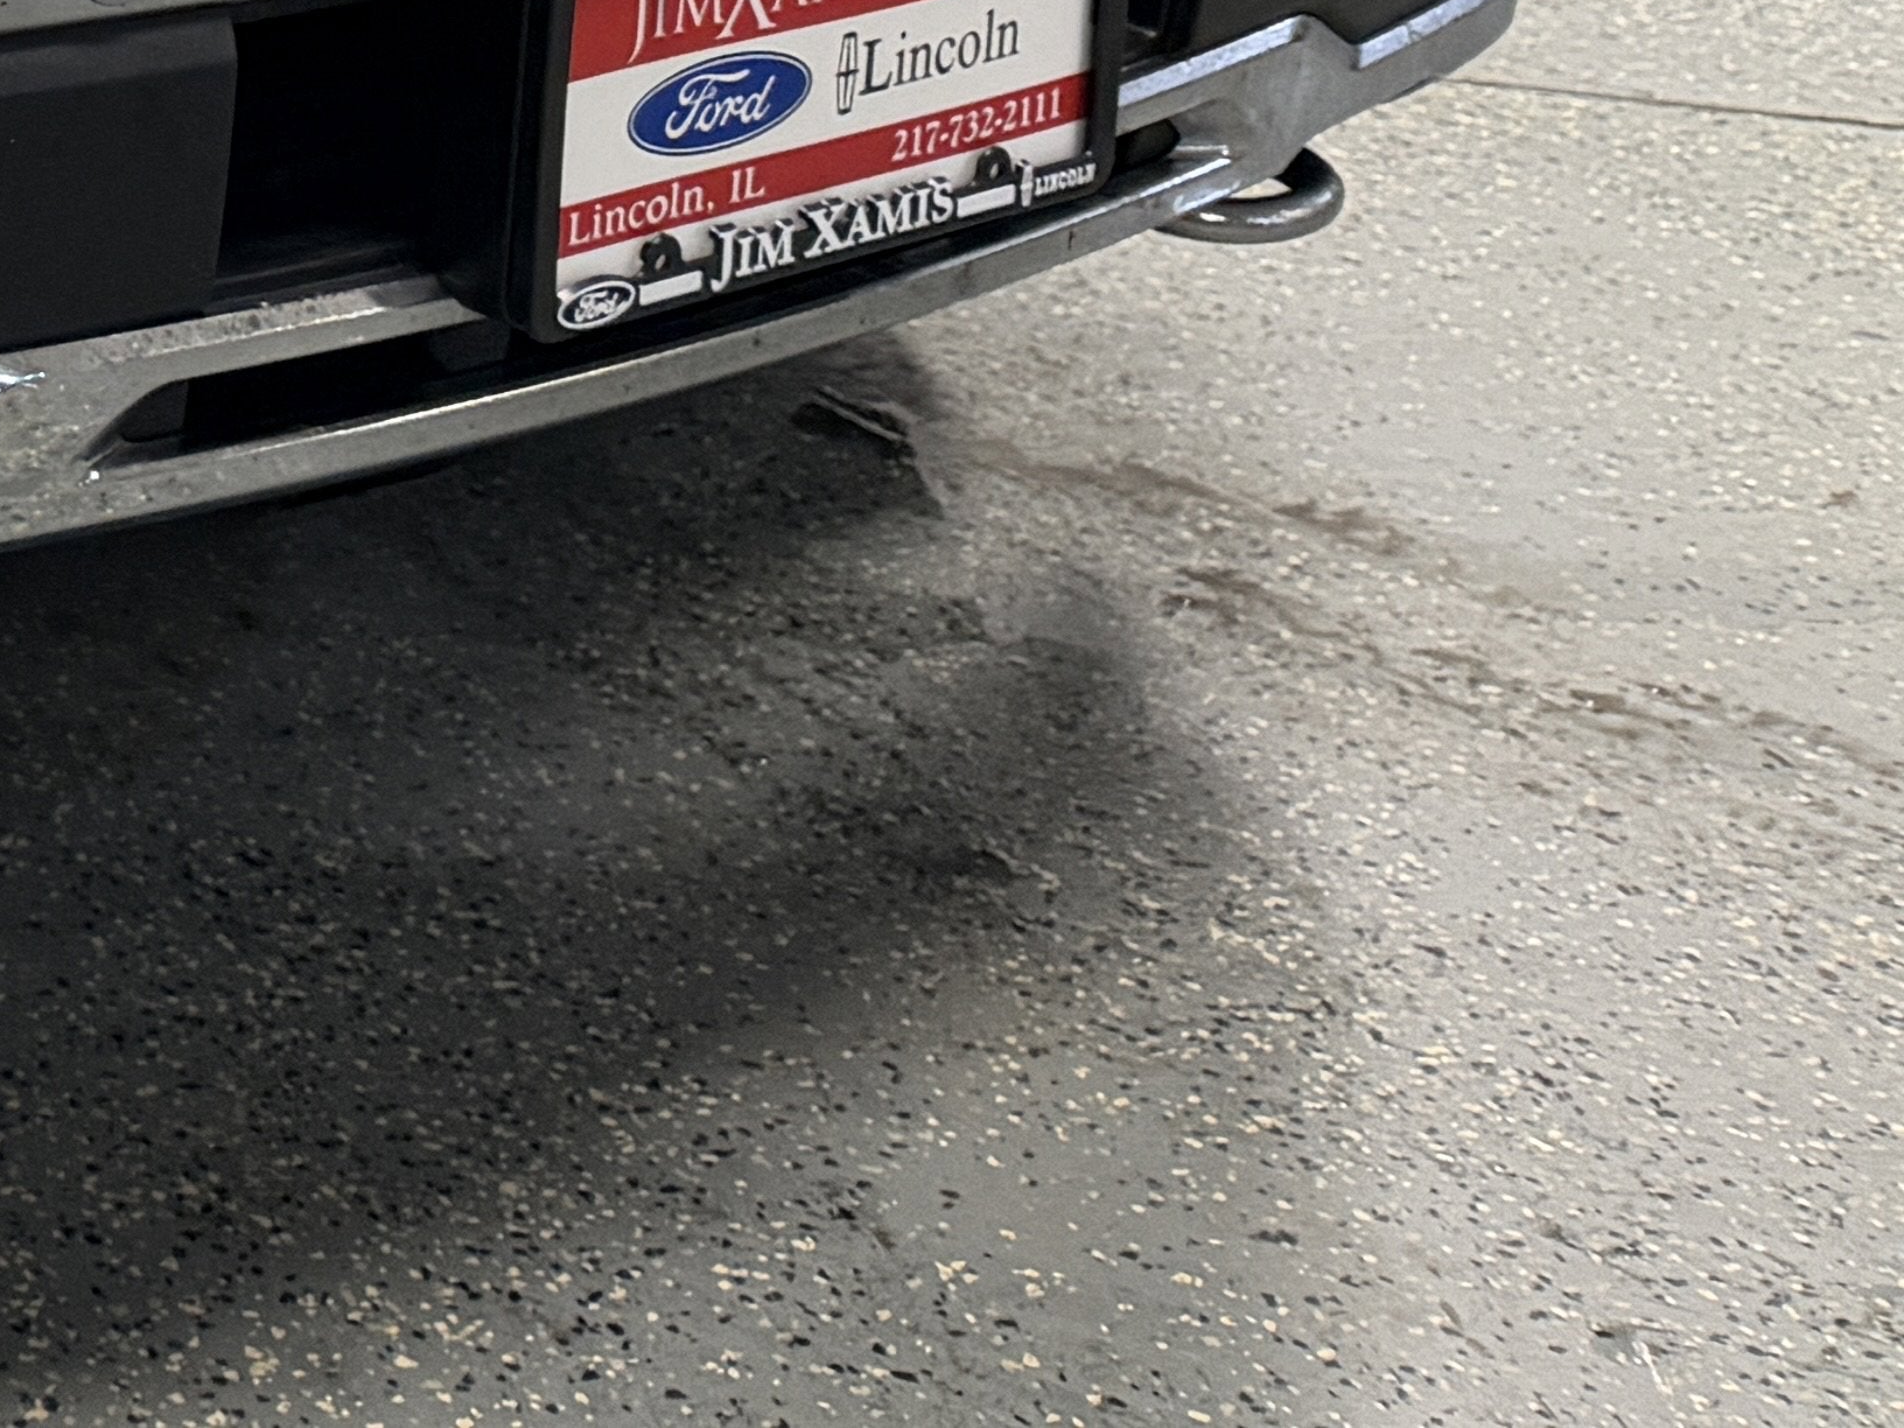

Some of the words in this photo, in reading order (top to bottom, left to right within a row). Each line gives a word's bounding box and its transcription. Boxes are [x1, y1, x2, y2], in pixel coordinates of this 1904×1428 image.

[859, 8, 1020, 96] Lincoln
[664, 67, 772, 142] Ford
[891, 86, 1061, 162] 217-732-2111
[568, 181, 715, 246] Lincoln,
[729, 167, 766, 204] IL
[1034, 162, 1097, 197] LINCOLN
[710, 221, 795, 293] JIM
[799, 180, 955, 259] XAMIS
[573, 292, 622, 324] Ford
